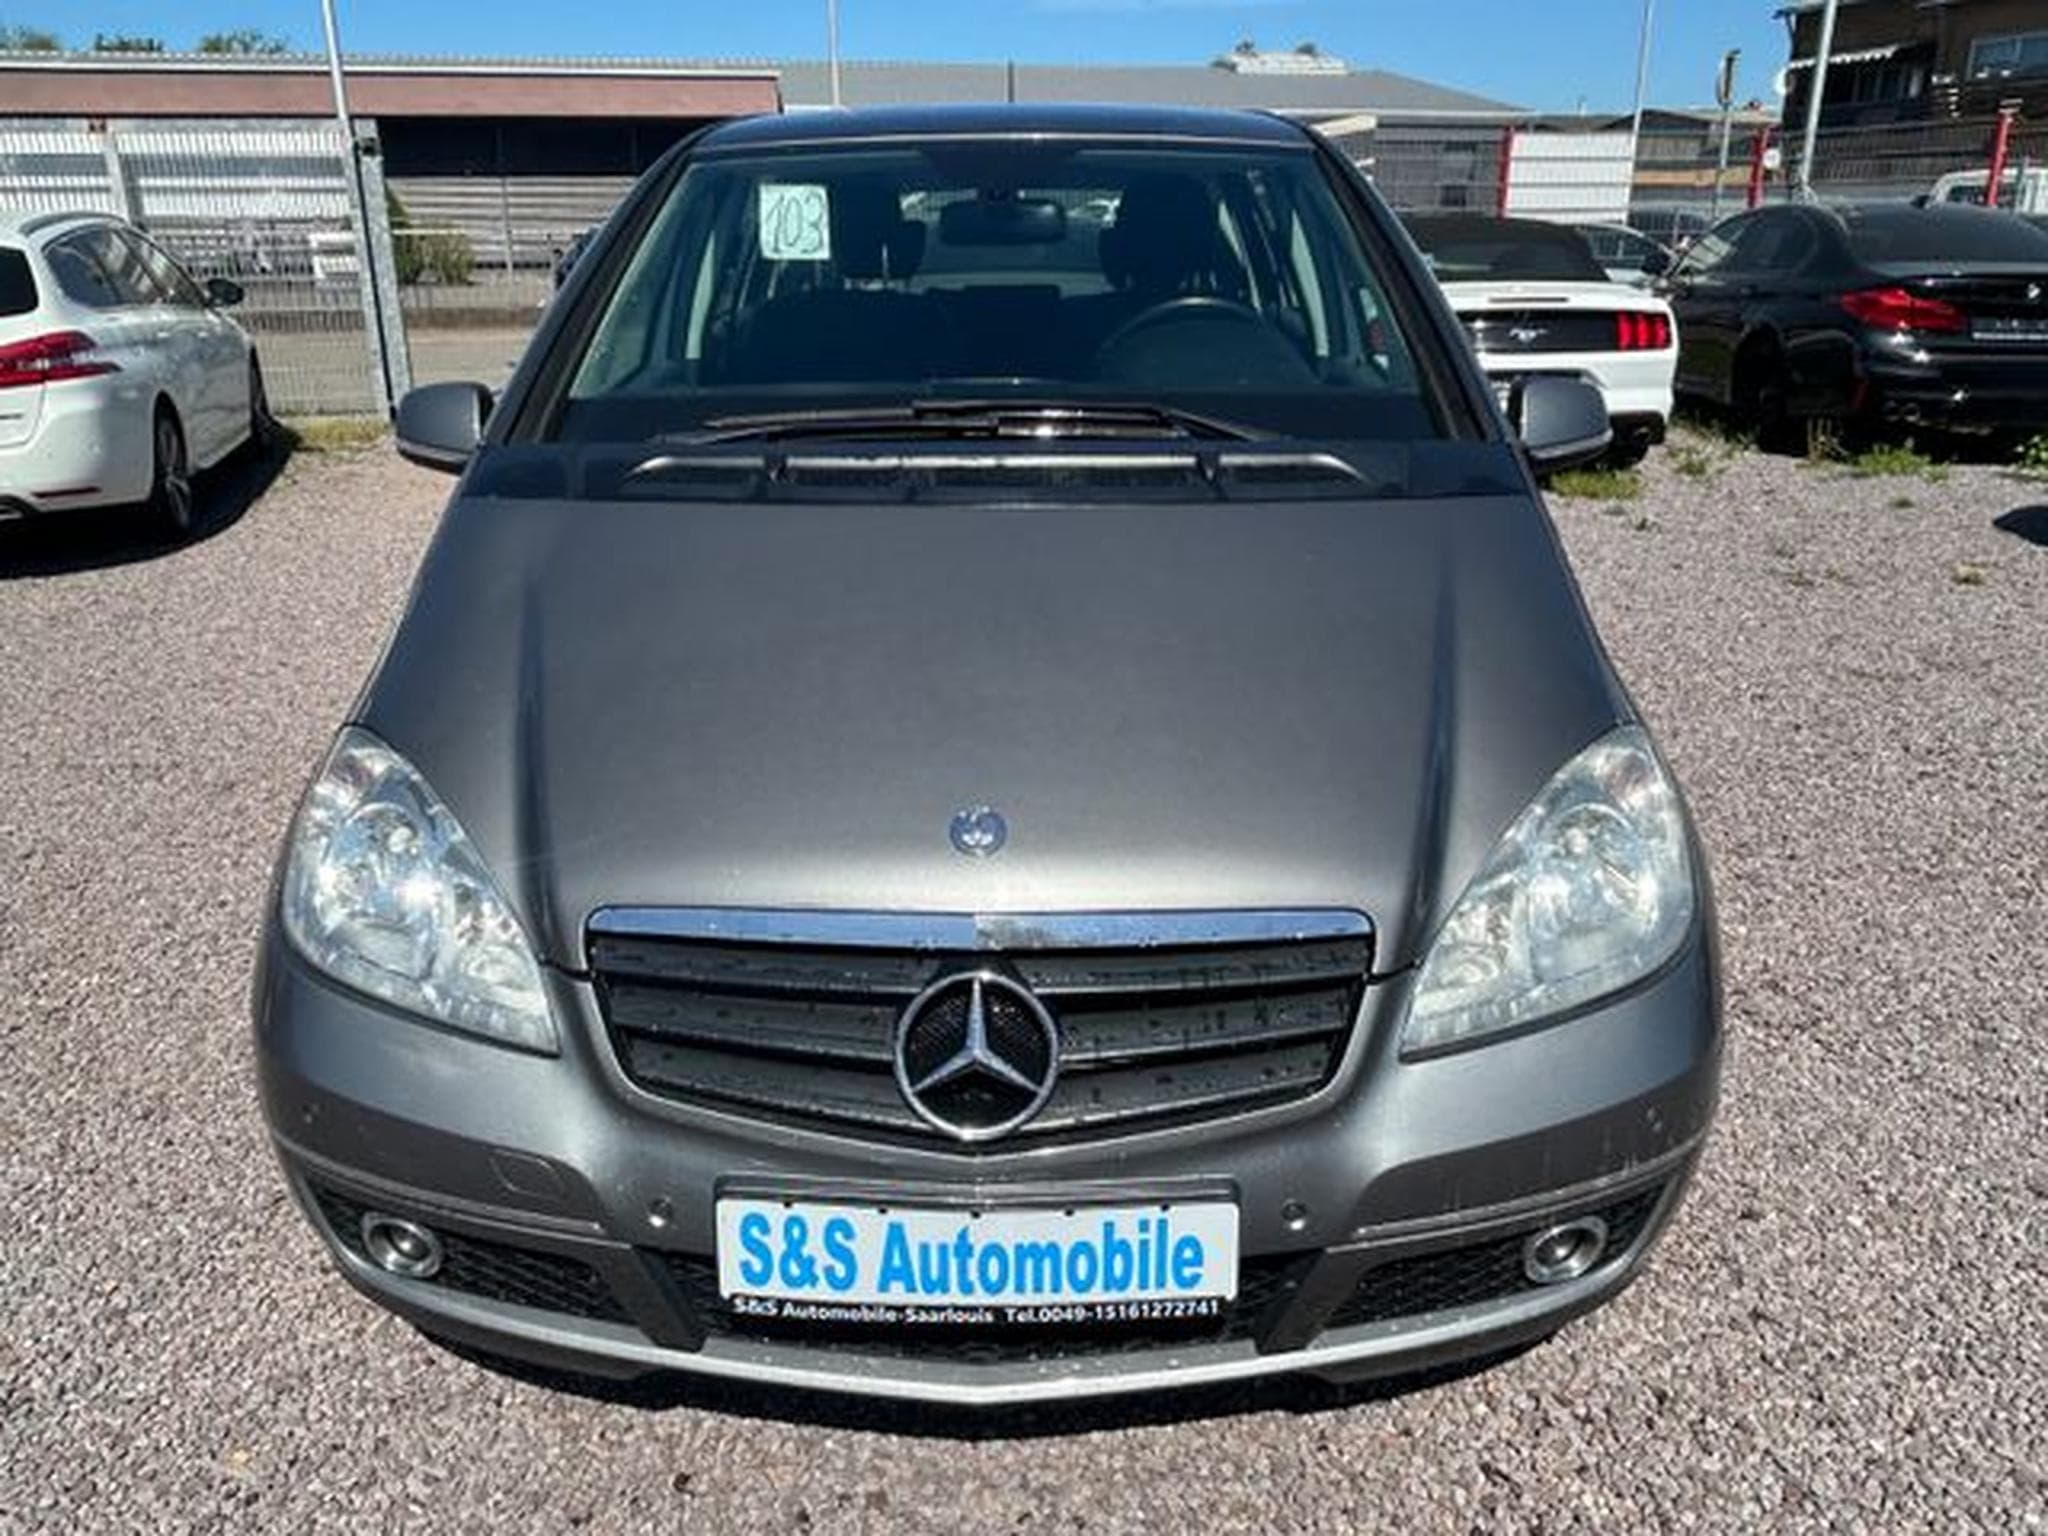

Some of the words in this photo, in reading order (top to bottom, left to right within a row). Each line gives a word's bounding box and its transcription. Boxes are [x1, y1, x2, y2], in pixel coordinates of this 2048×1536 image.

[765, 191, 825, 254] 103
[739, 1212, 858, 1290] S&S
[877, 1218, 1204, 1296] Automobile
[733, 1296, 778, 1316] S&S
